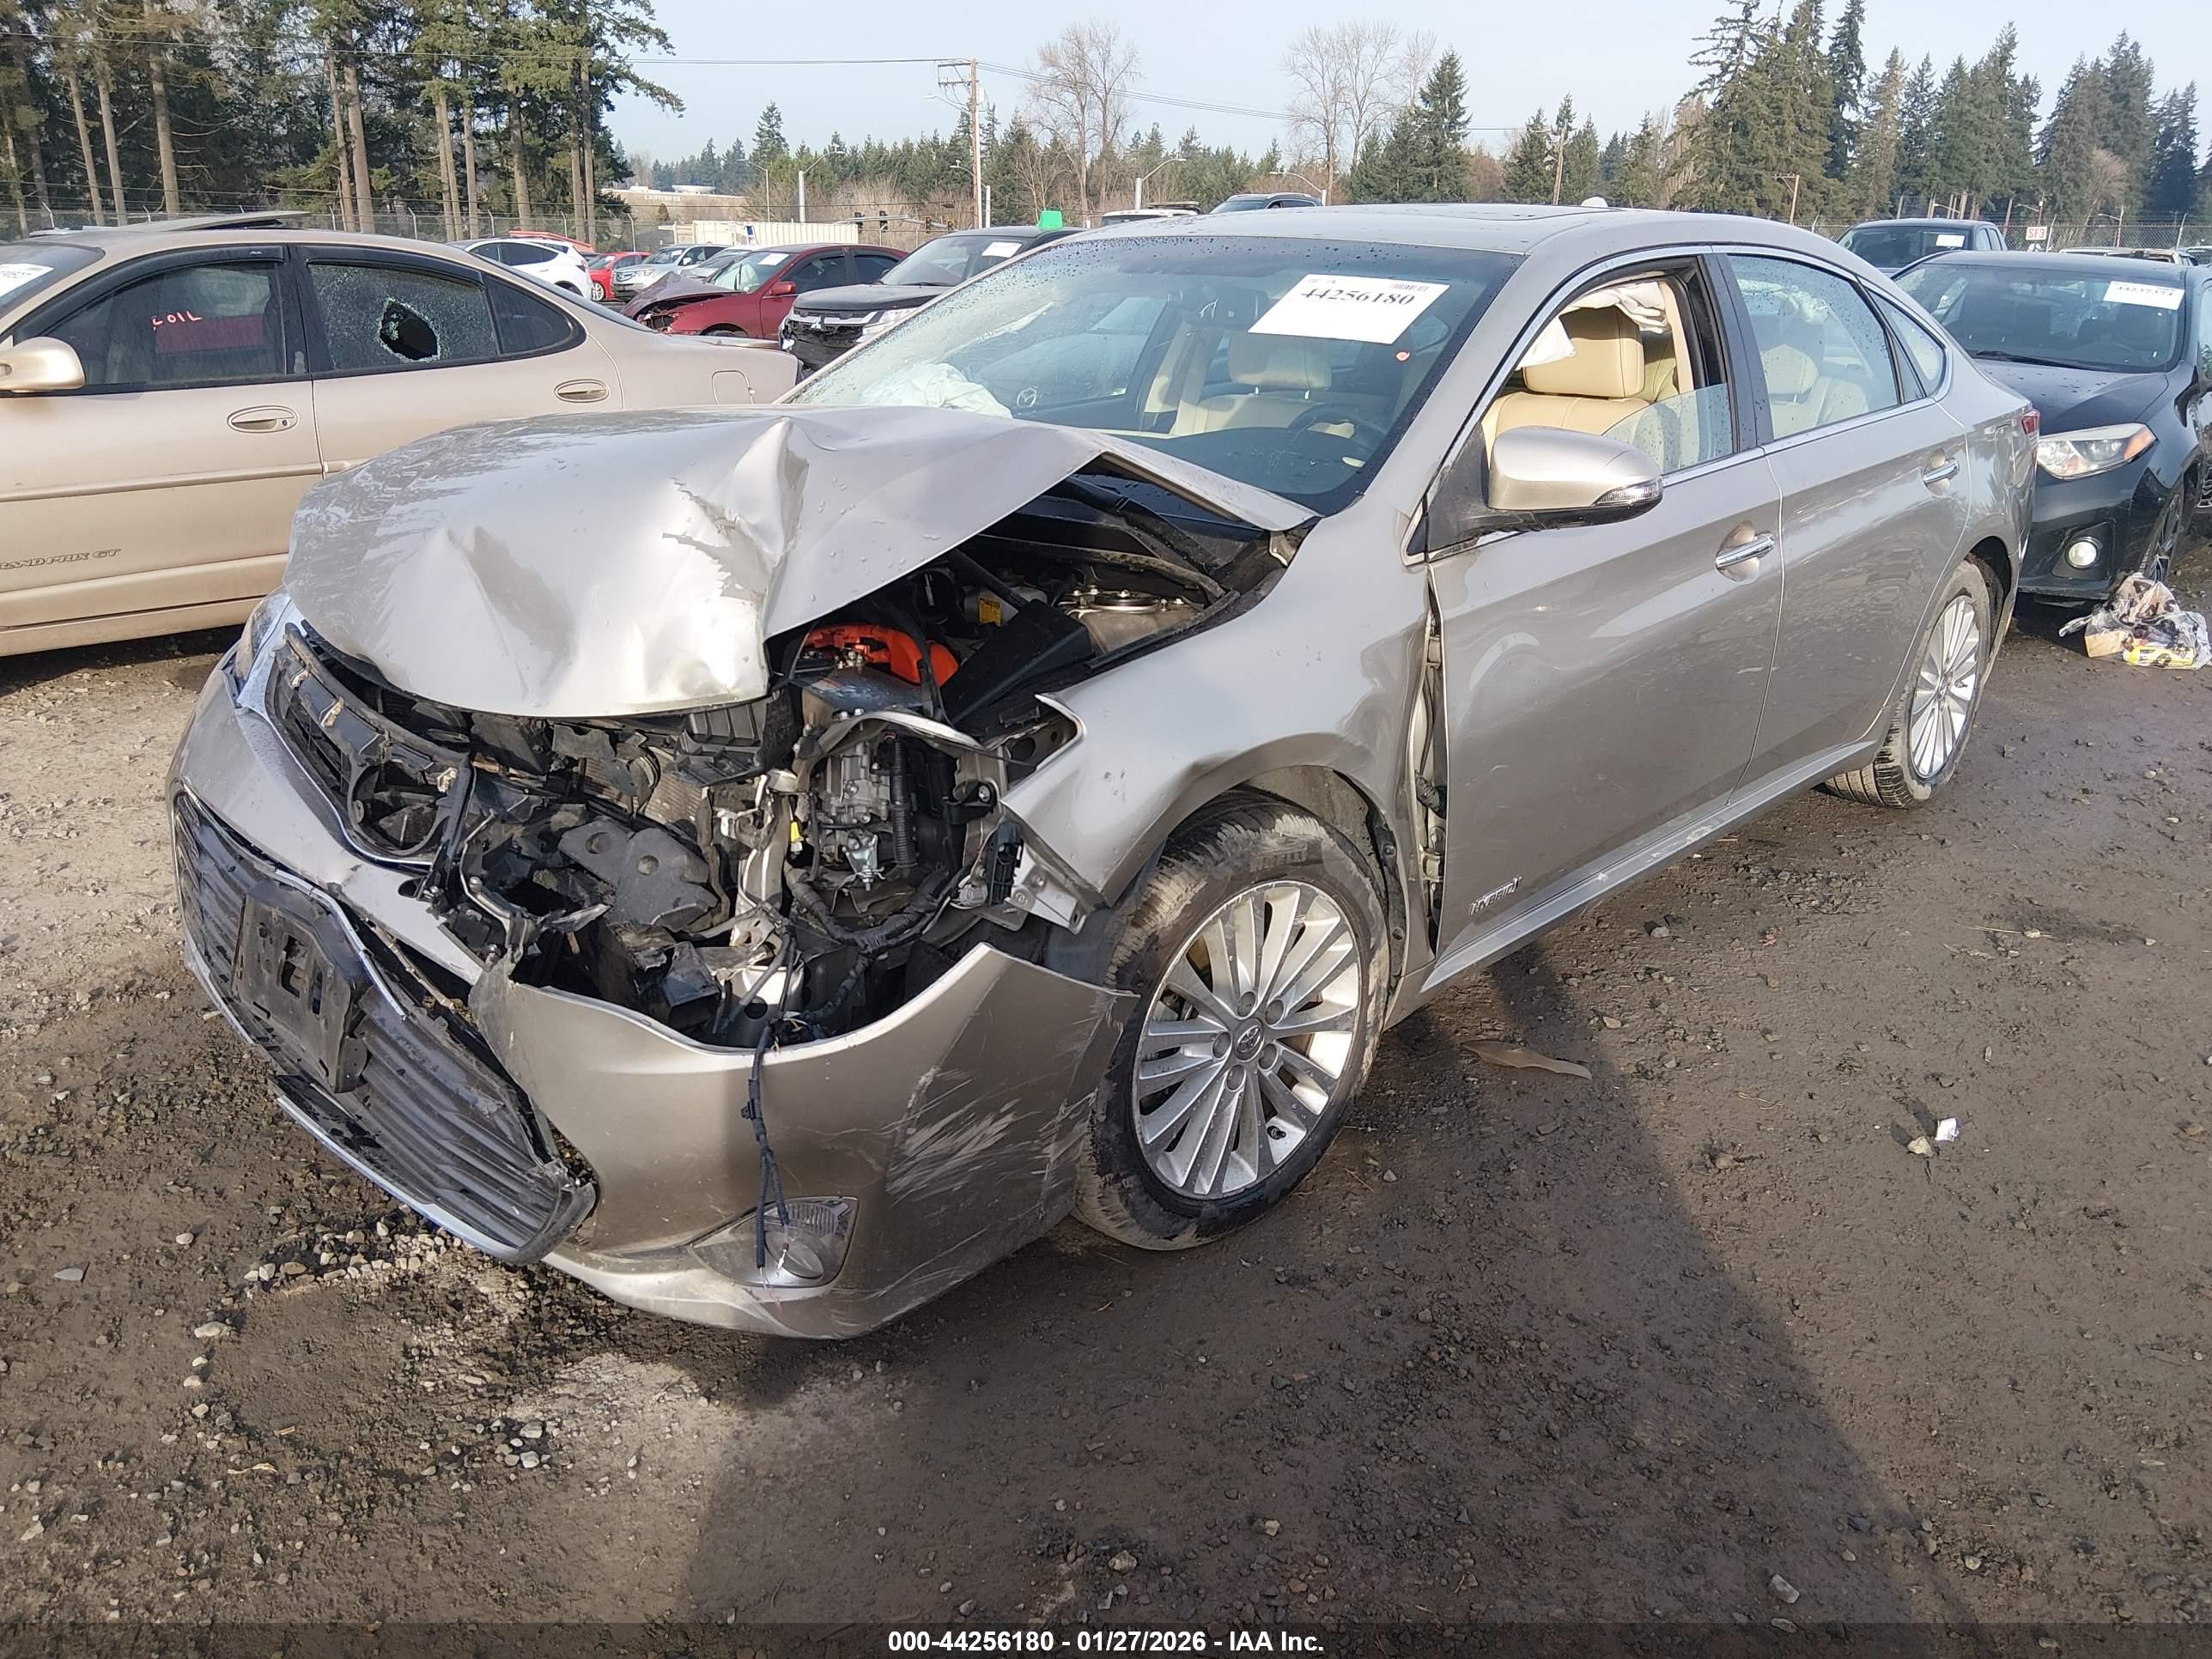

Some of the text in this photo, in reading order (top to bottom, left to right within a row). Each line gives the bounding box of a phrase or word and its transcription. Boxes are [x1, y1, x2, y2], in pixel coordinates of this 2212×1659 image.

[2028, 228, 2045, 239] SF3
[1301, 287, 1415, 306] 44256180
[46, 552, 90, 565] PRIX
[93, 548, 122, 558] GT
